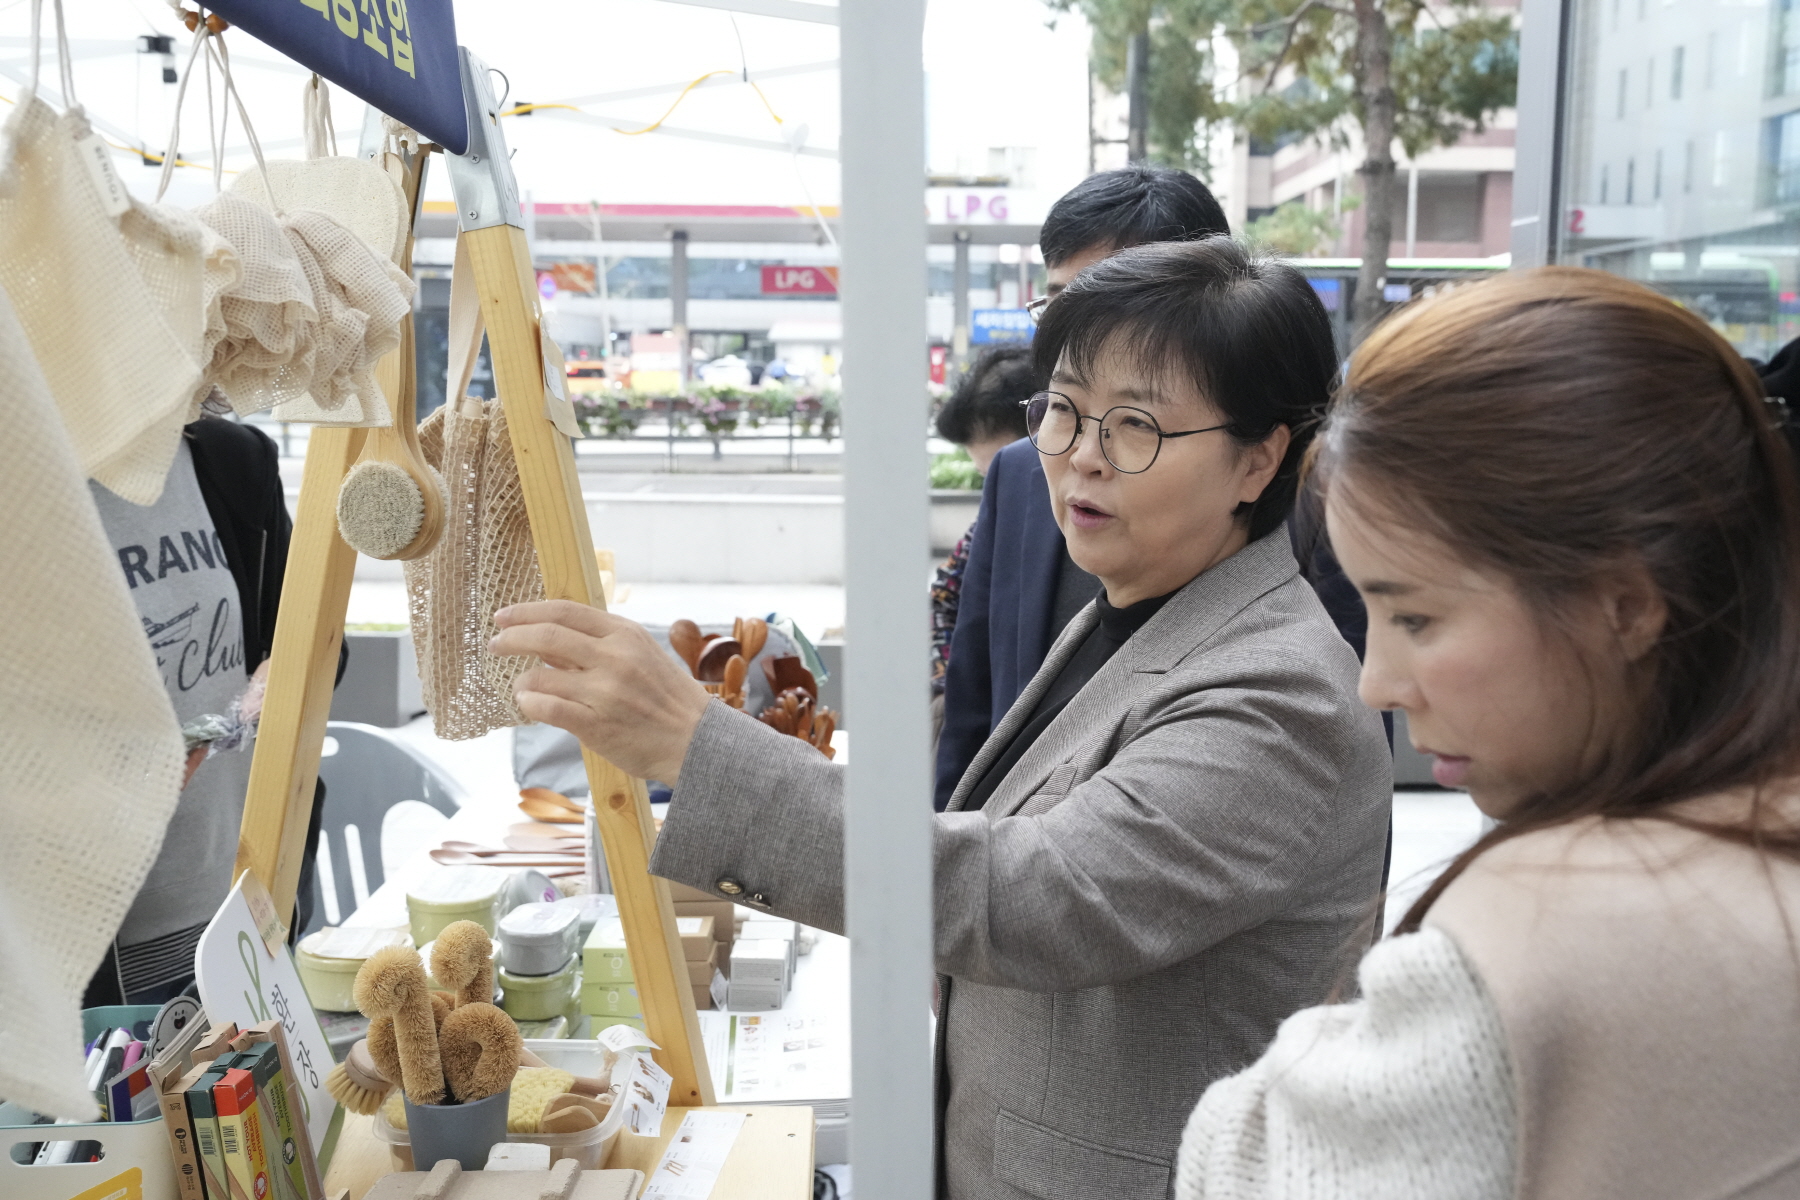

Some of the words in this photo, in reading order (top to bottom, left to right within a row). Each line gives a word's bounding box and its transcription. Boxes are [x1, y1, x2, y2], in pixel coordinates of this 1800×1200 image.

[946, 194, 1008, 219] LPG
[774, 269, 816, 289] LPG
[278, 1081, 291, 1133] TOOTHBRUSH
[243, 1120, 251, 1143] YOUR
[252, 1112, 264, 1167] TOOTHBRUSH
